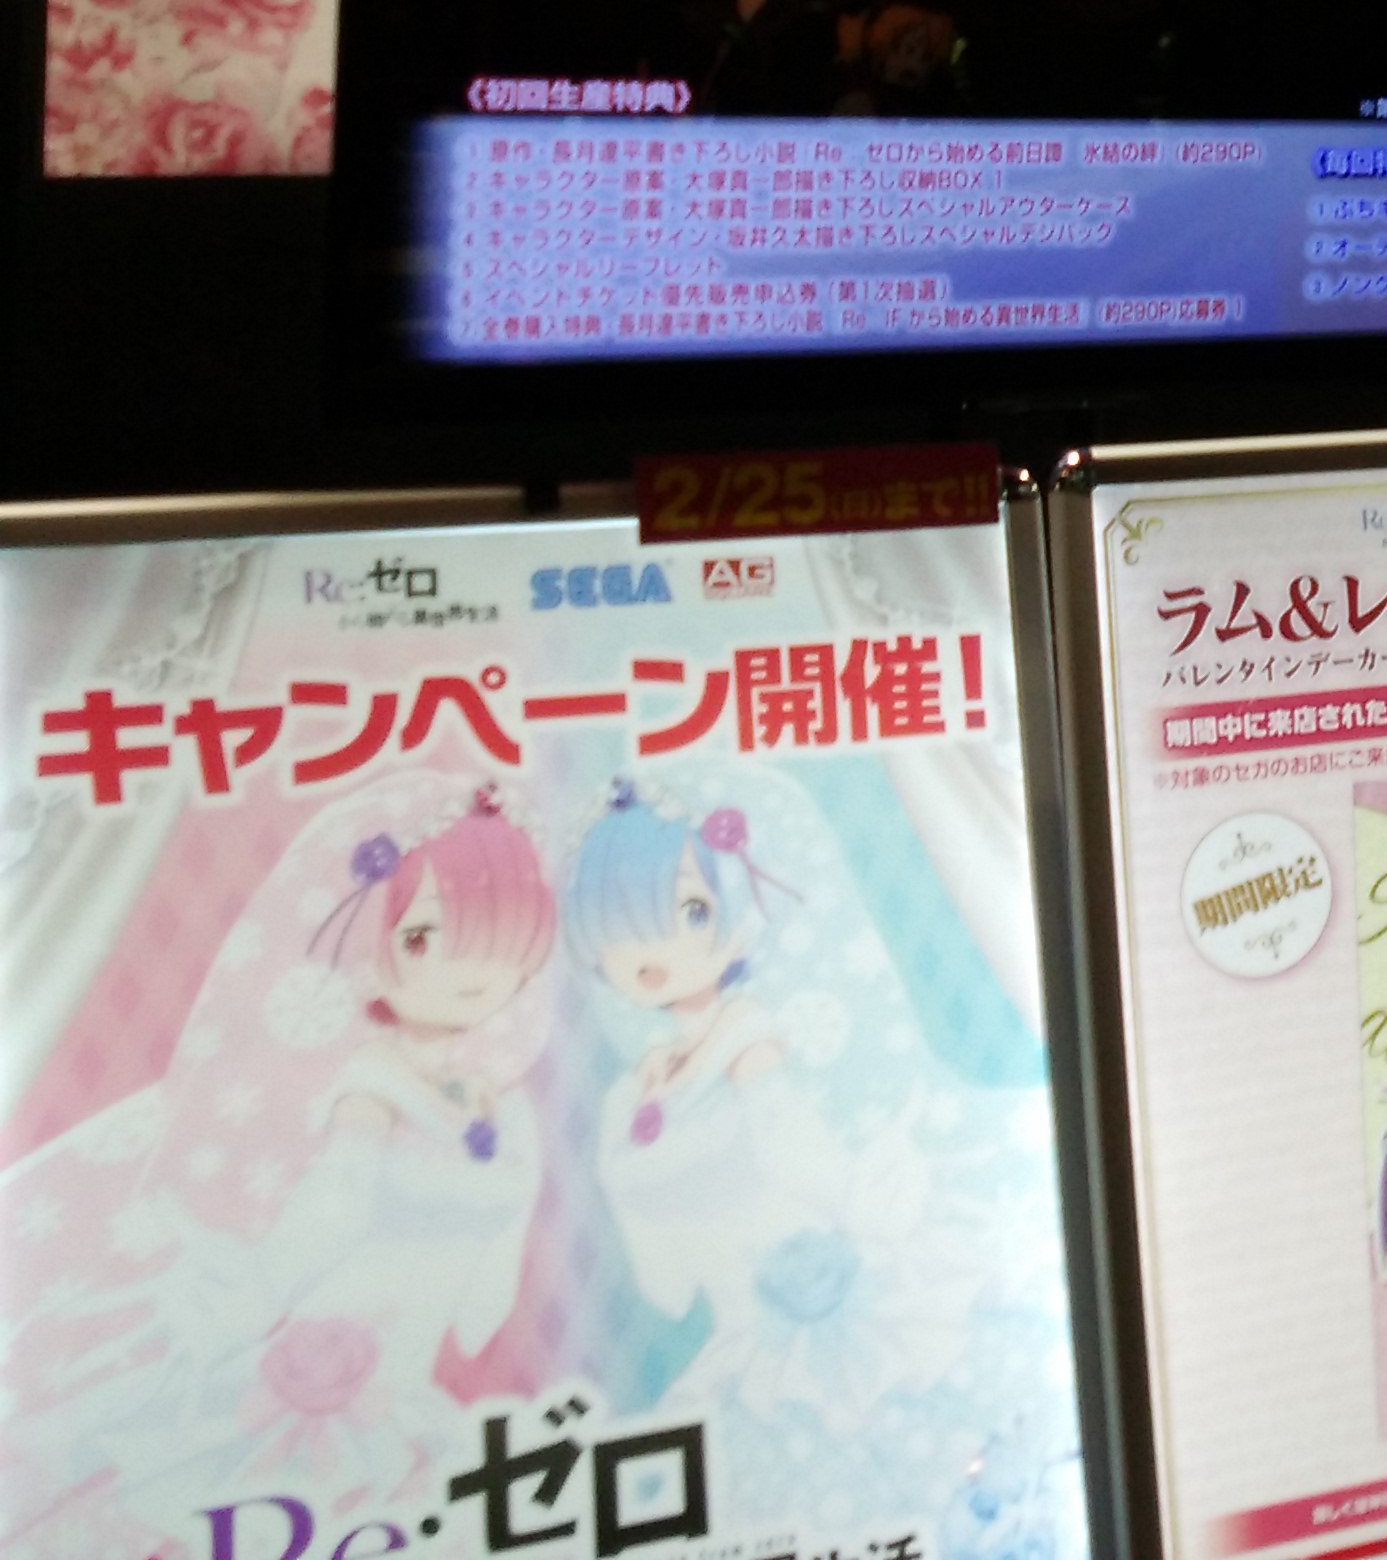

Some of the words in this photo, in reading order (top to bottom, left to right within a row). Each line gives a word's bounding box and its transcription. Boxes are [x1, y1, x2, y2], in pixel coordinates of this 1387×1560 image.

[531, 562, 673, 610] SEGA
[37, 633, 988, 805] キャンペーン開催!
